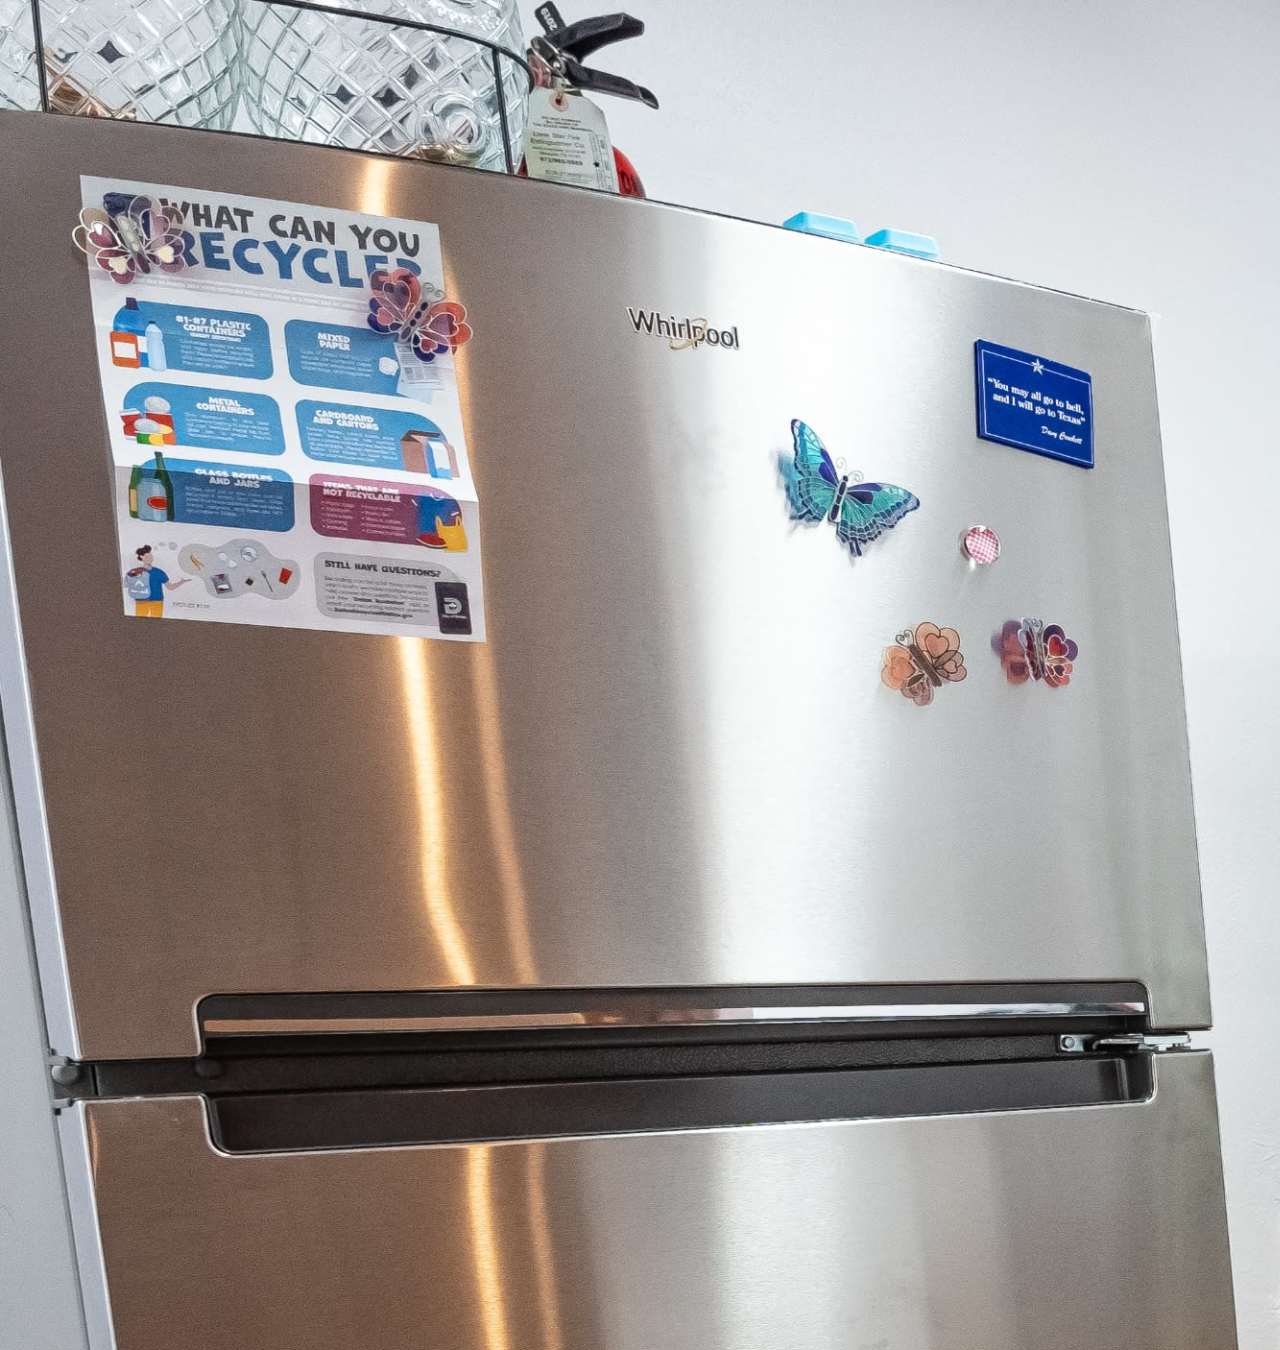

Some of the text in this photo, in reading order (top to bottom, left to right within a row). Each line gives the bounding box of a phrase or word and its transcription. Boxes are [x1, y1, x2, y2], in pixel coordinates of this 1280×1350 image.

[158, 198, 419, 257] WHAT CAN YOU
[183, 323, 246, 337] CONTAINERS
[626, 306, 740, 350] Whirlpool
[319, 340, 351, 351] PAPER
[208, 396, 241, 407] METAL
[992, 393, 1010, 404] and
[1018, 399, 1033, 411] will
[1035, 406, 1046, 415] go
[1047, 408, 1056, 418] to
[1011, 385, 1029, 399] may
[1031, 391, 1041, 401] all
[1043, 395, 1054, 406] go
[1055, 398, 1064, 408] to
[209, 476, 230, 485] AND
[324, 559, 442, 578] STILL HAVE QUESTIONS?
